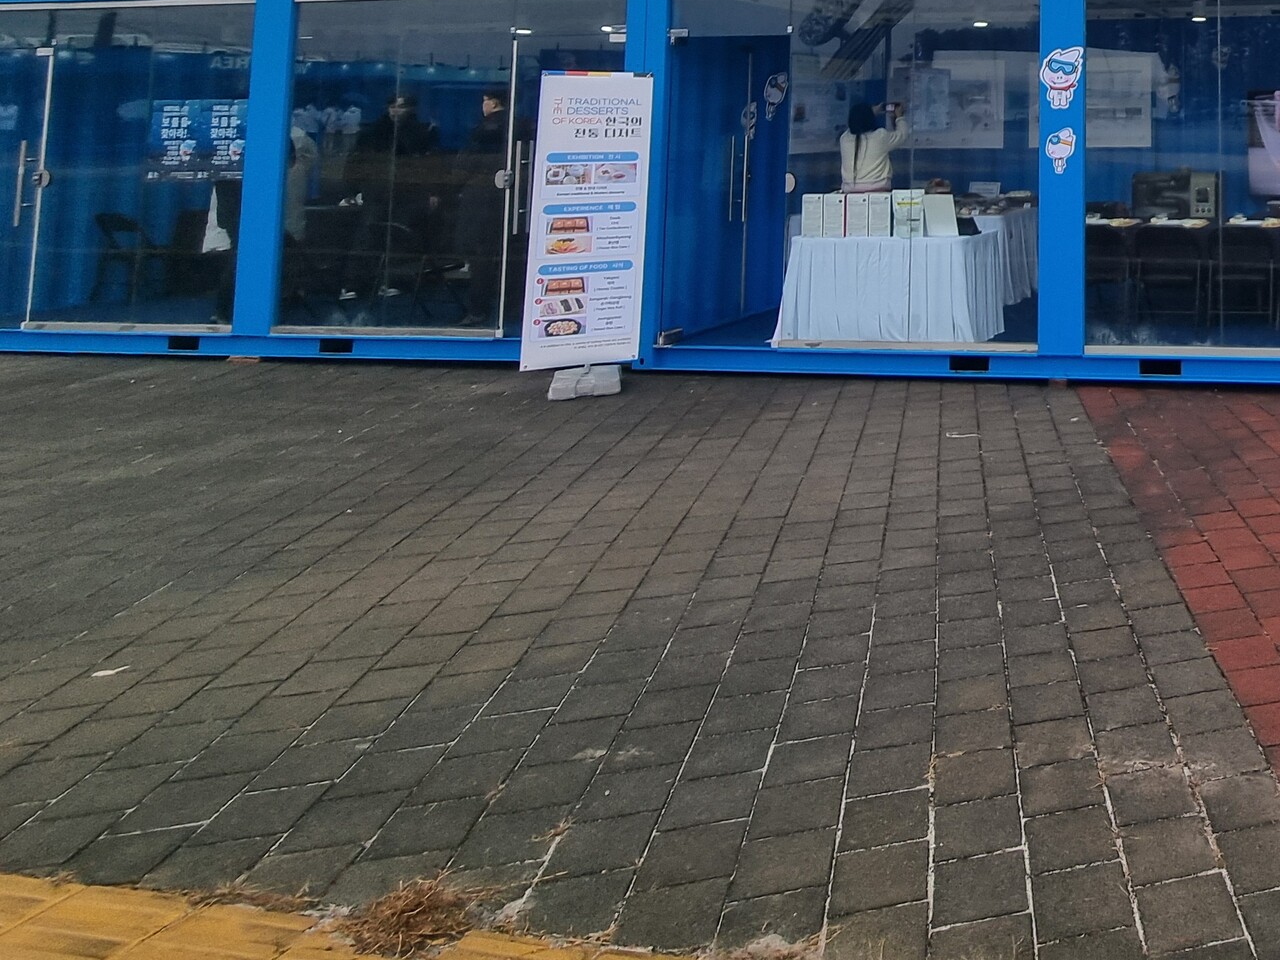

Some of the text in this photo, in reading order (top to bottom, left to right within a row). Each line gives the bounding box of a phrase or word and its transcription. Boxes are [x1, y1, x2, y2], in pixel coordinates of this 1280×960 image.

[568, 97, 642, 106] TRADITIONAL
[566, 107, 629, 115] DESSERTS
[552, 117, 602, 125] OF KOREA
[605, 116, 642, 127] 한국의
[604, 128, 642, 138] 디저트
